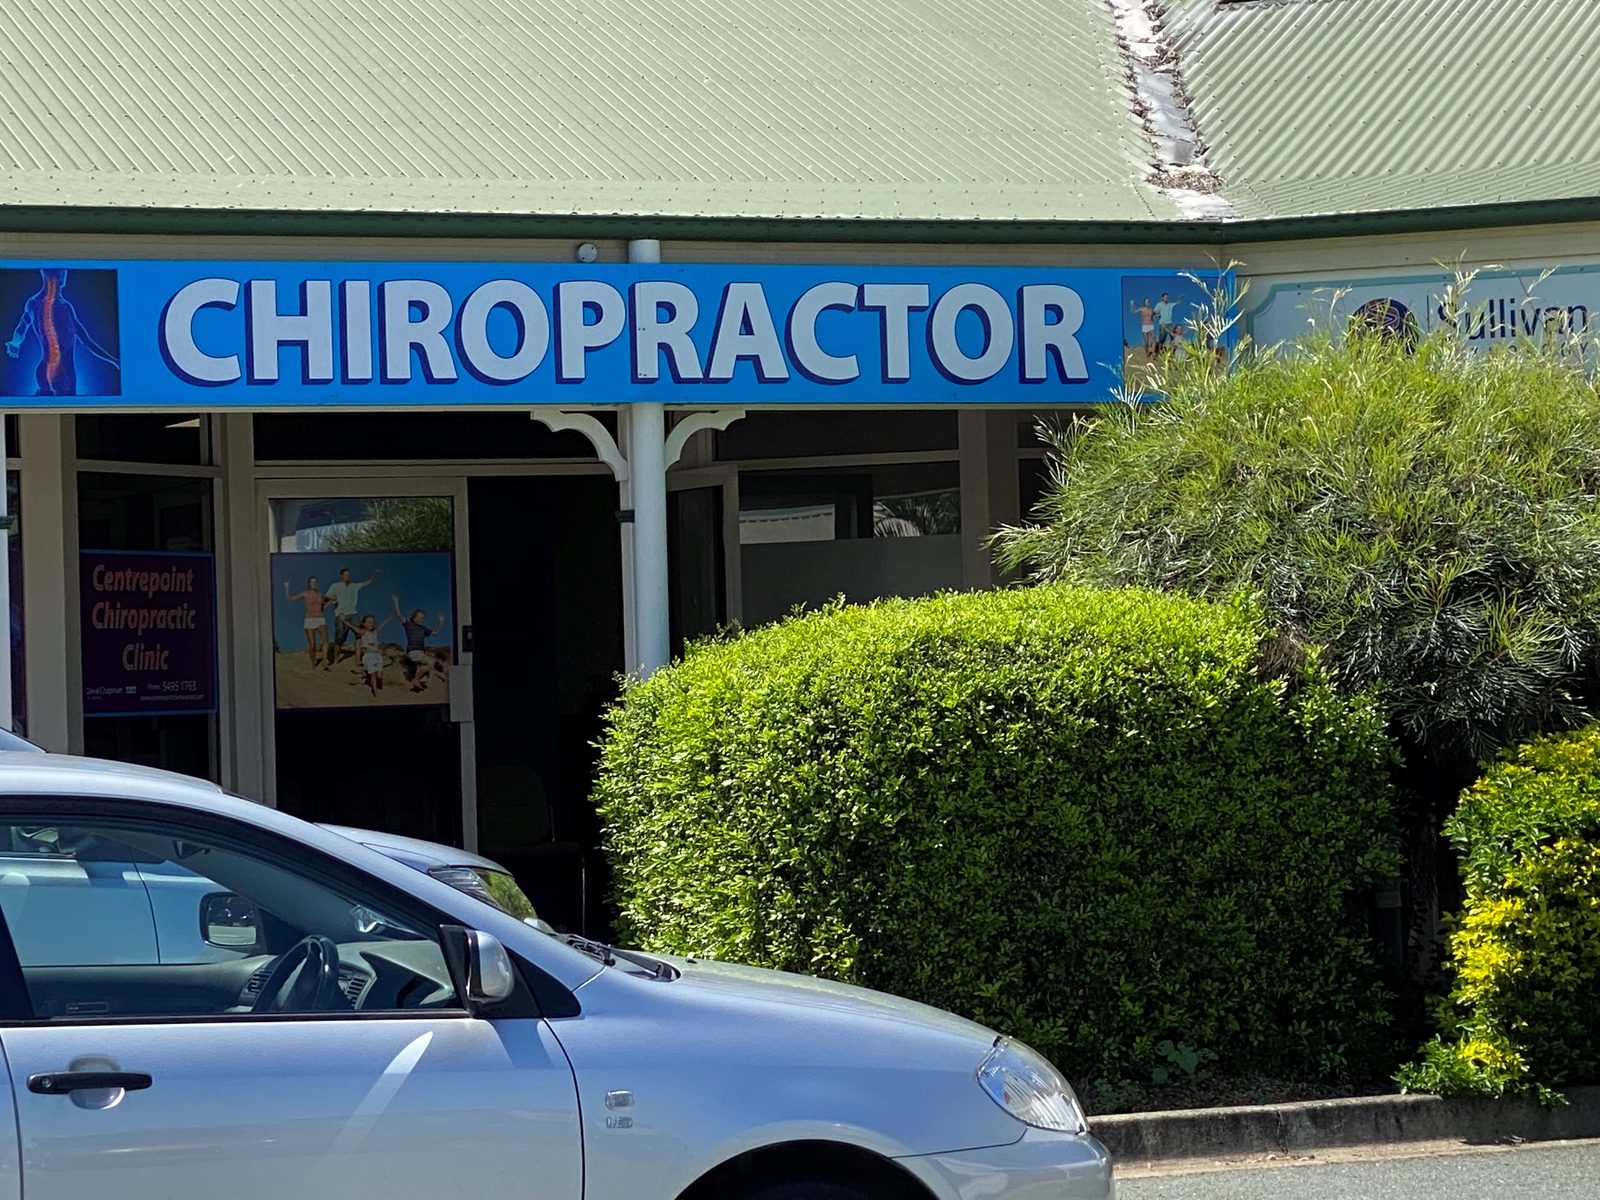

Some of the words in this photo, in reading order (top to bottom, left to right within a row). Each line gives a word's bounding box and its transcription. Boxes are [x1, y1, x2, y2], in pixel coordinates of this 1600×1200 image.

[158, 277, 1090, 386] CHIROPRACTOR
[1437, 297, 1589, 340] Sullivan
[92, 563, 194, 599] Centrepoint
[91, 600, 197, 637] Chiropractic
[121, 642, 170, 672] Clinic
